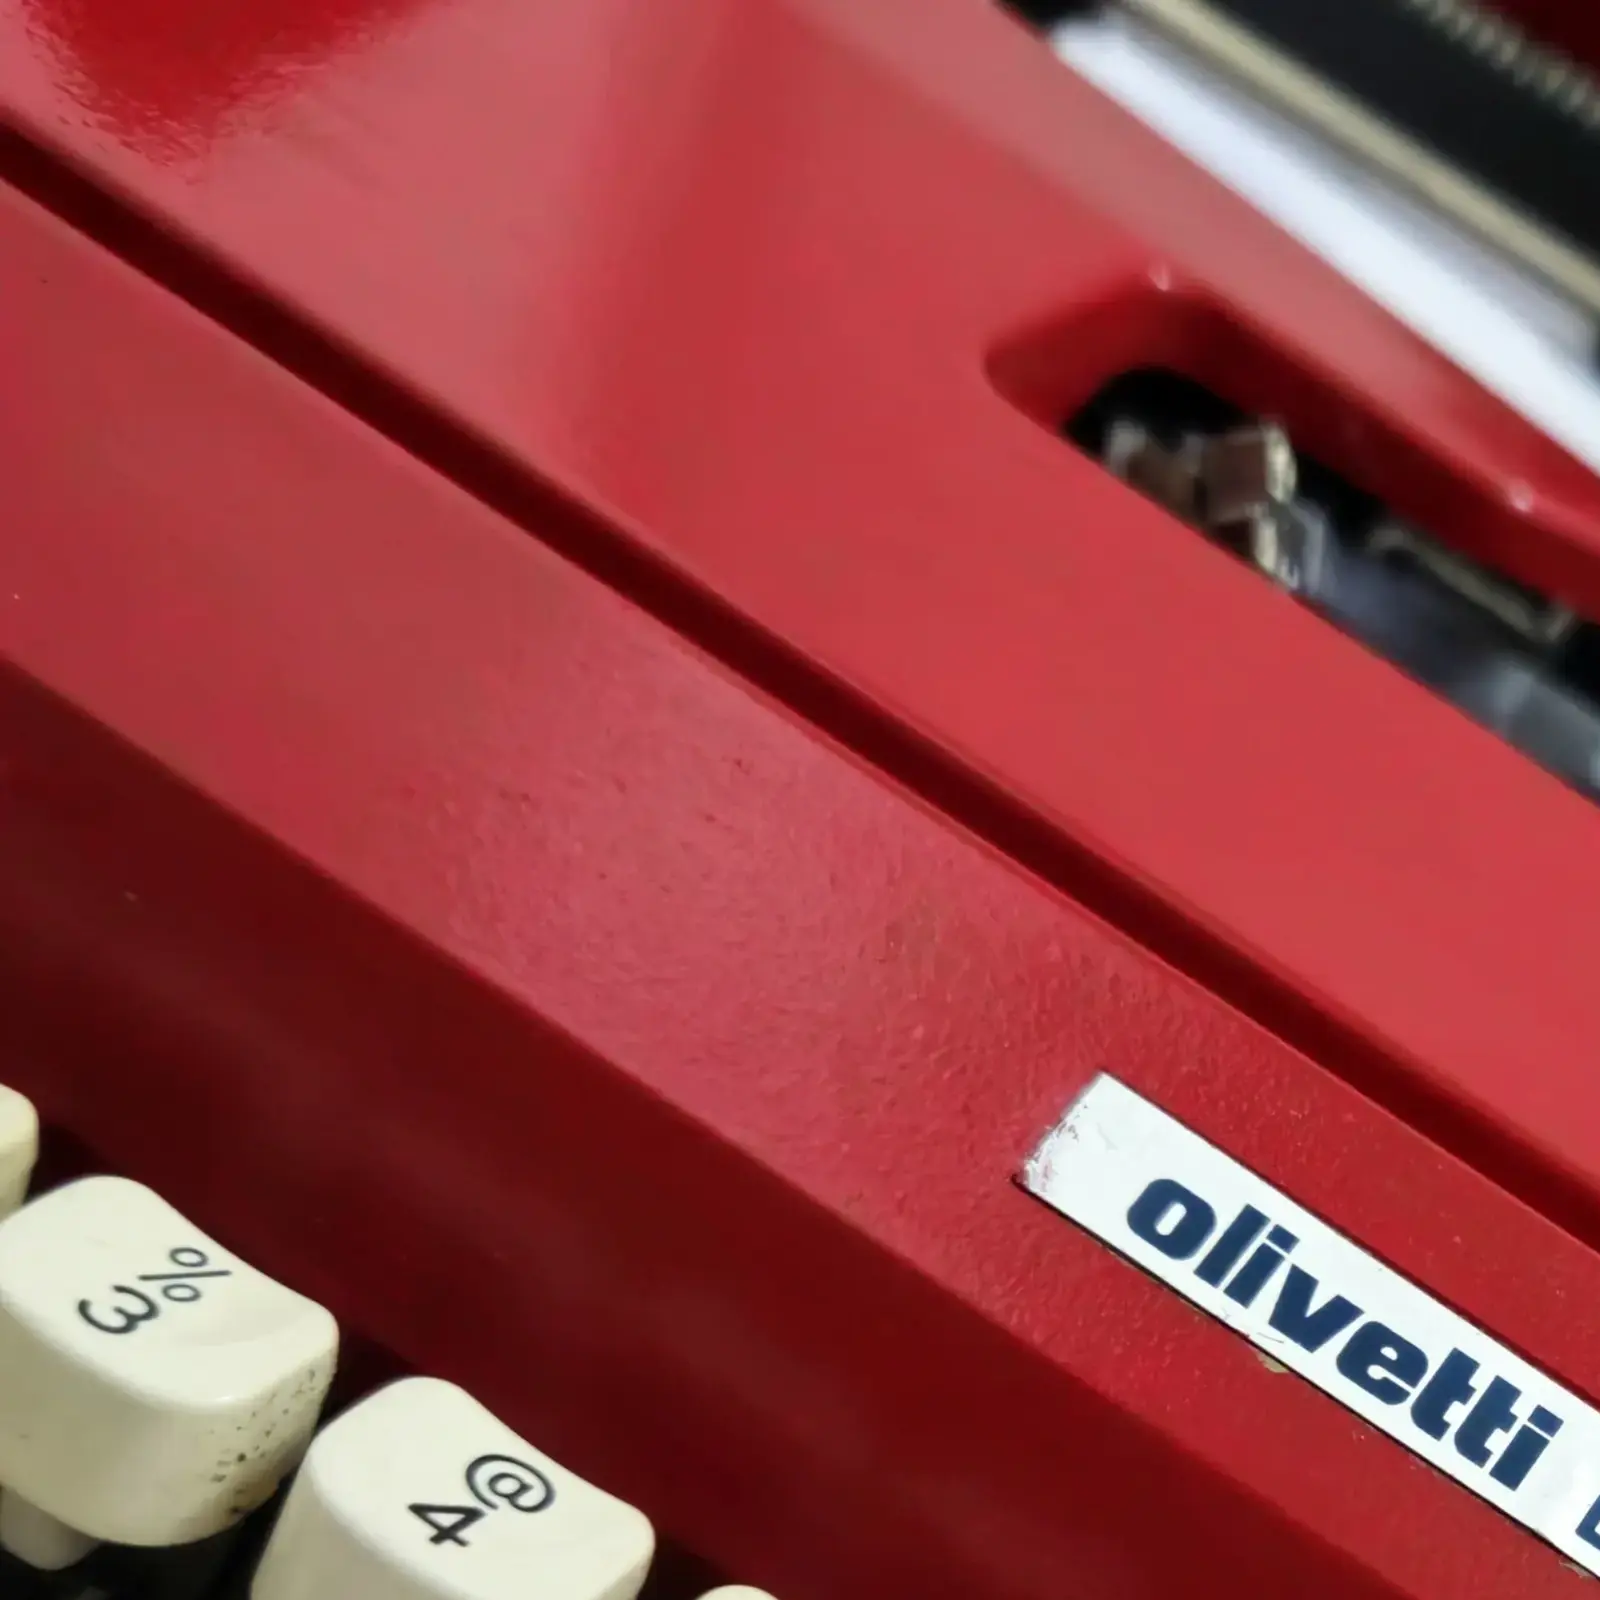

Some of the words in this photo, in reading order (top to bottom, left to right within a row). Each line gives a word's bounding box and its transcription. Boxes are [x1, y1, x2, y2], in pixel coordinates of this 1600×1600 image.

[138, 1246, 231, 1303] %
[77, 1285, 160, 1335] 3
[1126, 1178, 1564, 1491] olivetti
[465, 1453, 555, 1514] @
[407, 1503, 485, 1548] 4
